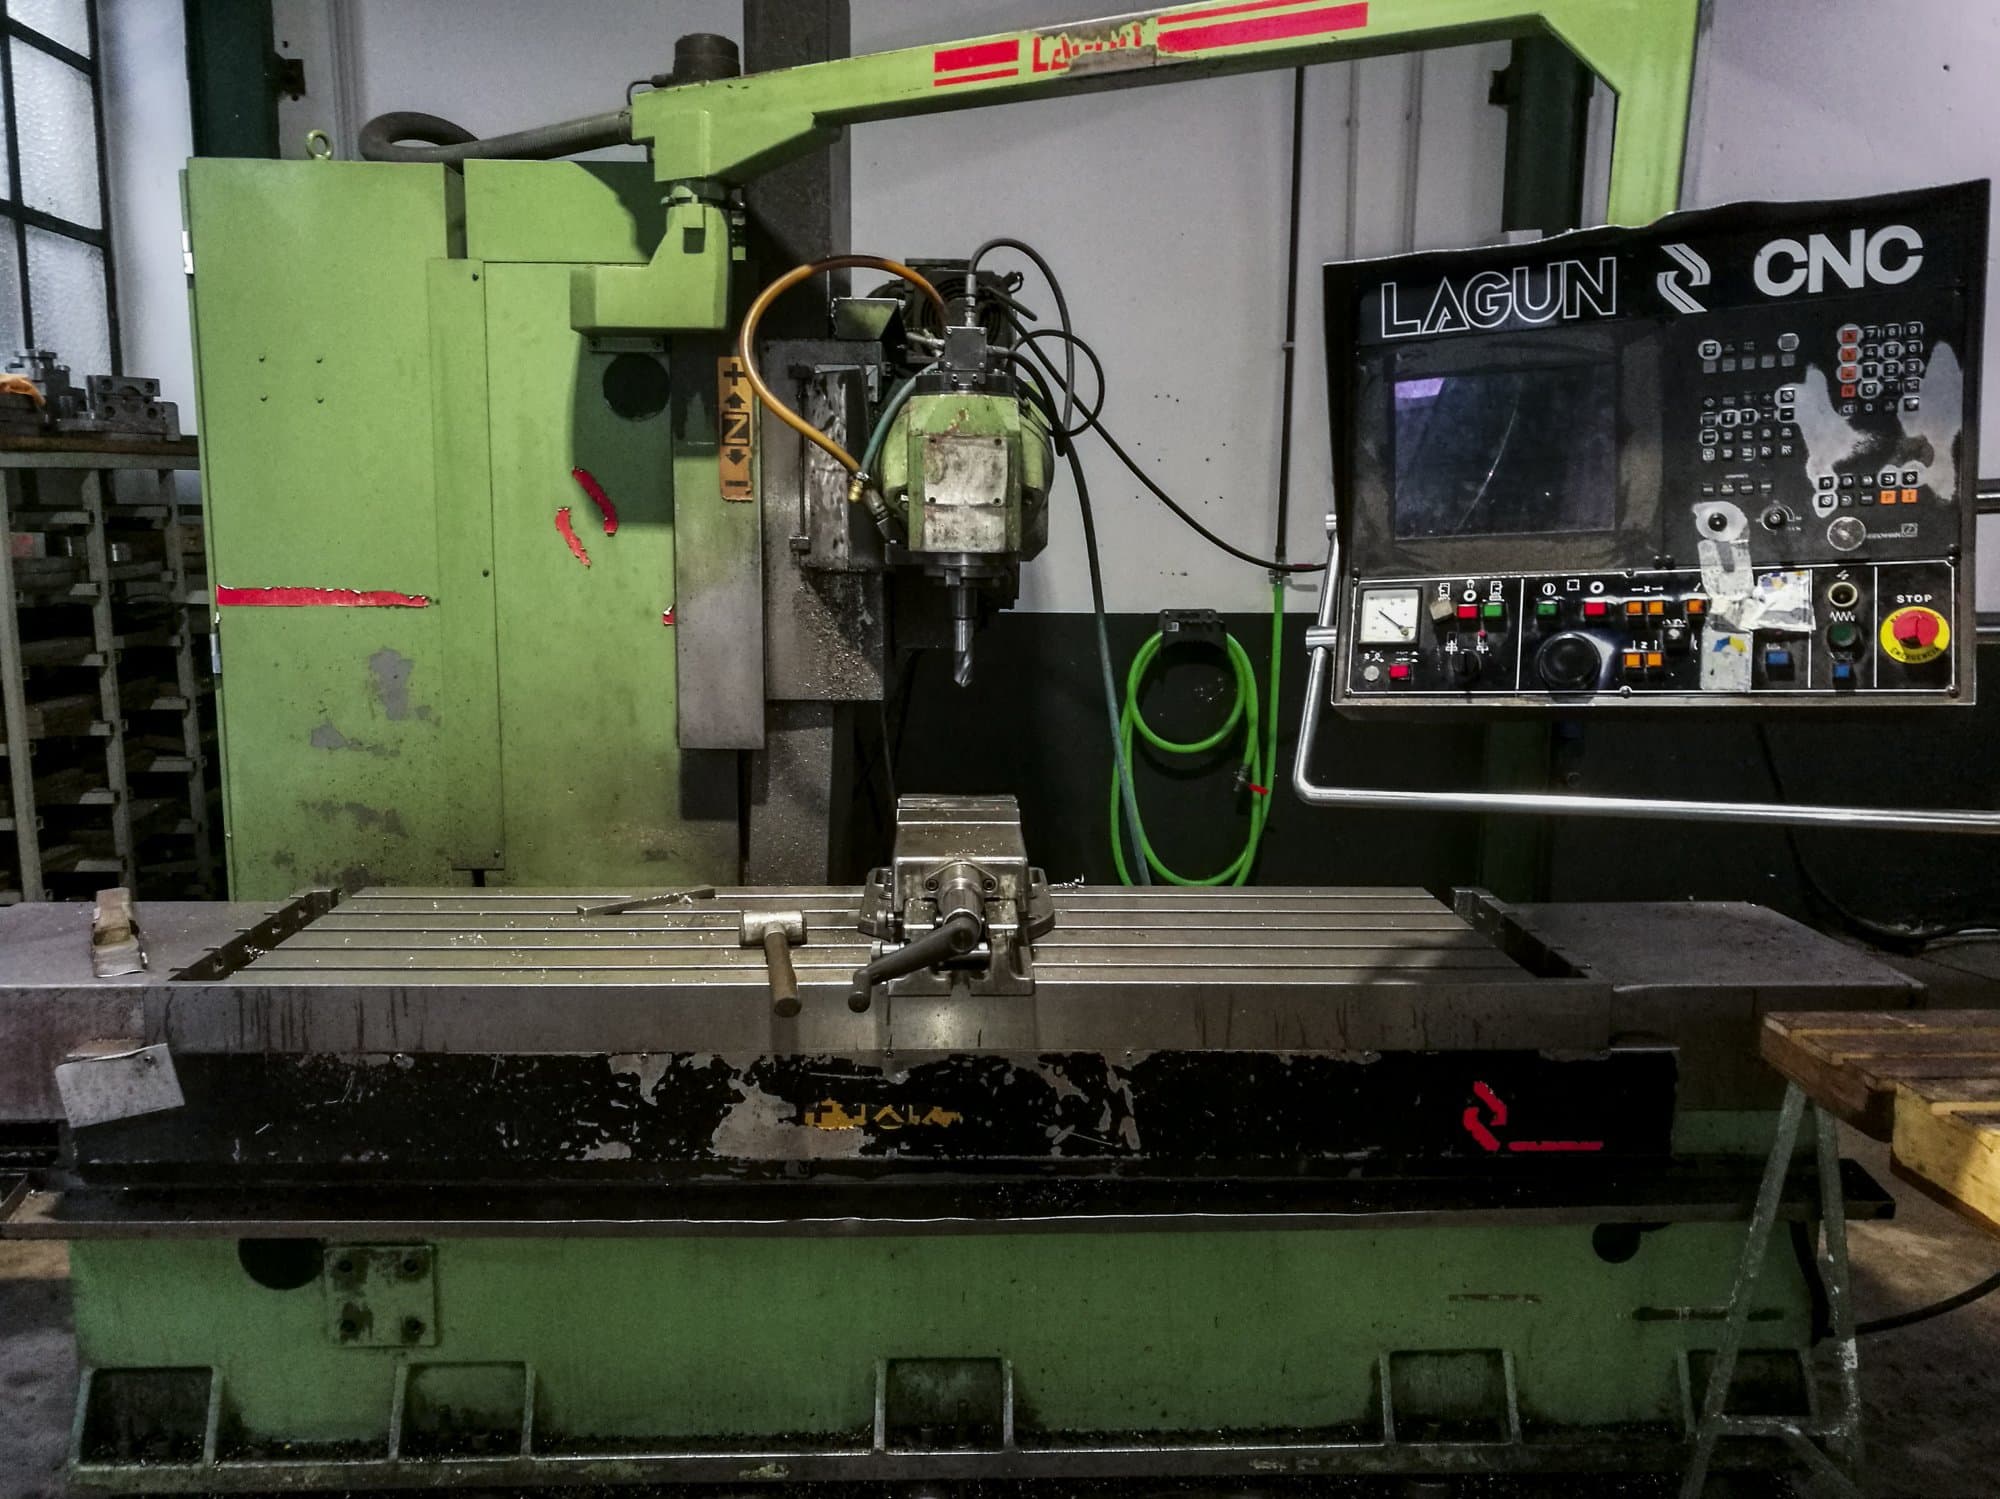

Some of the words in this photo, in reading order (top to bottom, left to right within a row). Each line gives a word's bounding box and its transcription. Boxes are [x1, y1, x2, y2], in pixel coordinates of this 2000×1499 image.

[1382, 256, 1617, 339] LAGUN
[1753, 225, 1924, 297] CNC
[1866, 330, 1875, 338] 7
[1888, 328, 1896, 336] 8
[1909, 325, 1918, 334] 9
[1888, 345, 1896, 354] 5
[1909, 343, 1918, 353] 6
[1888, 364, 1895, 373] 2
[1910, 363, 1917, 371] 3
[1842, 404, 1854, 414] CE
[725, 413, 748, 445] Z
[1644, 585, 1651, 593] X
[1896, 594, 1933, 604] STOP
[1640, 641, 1648, 649] Z
